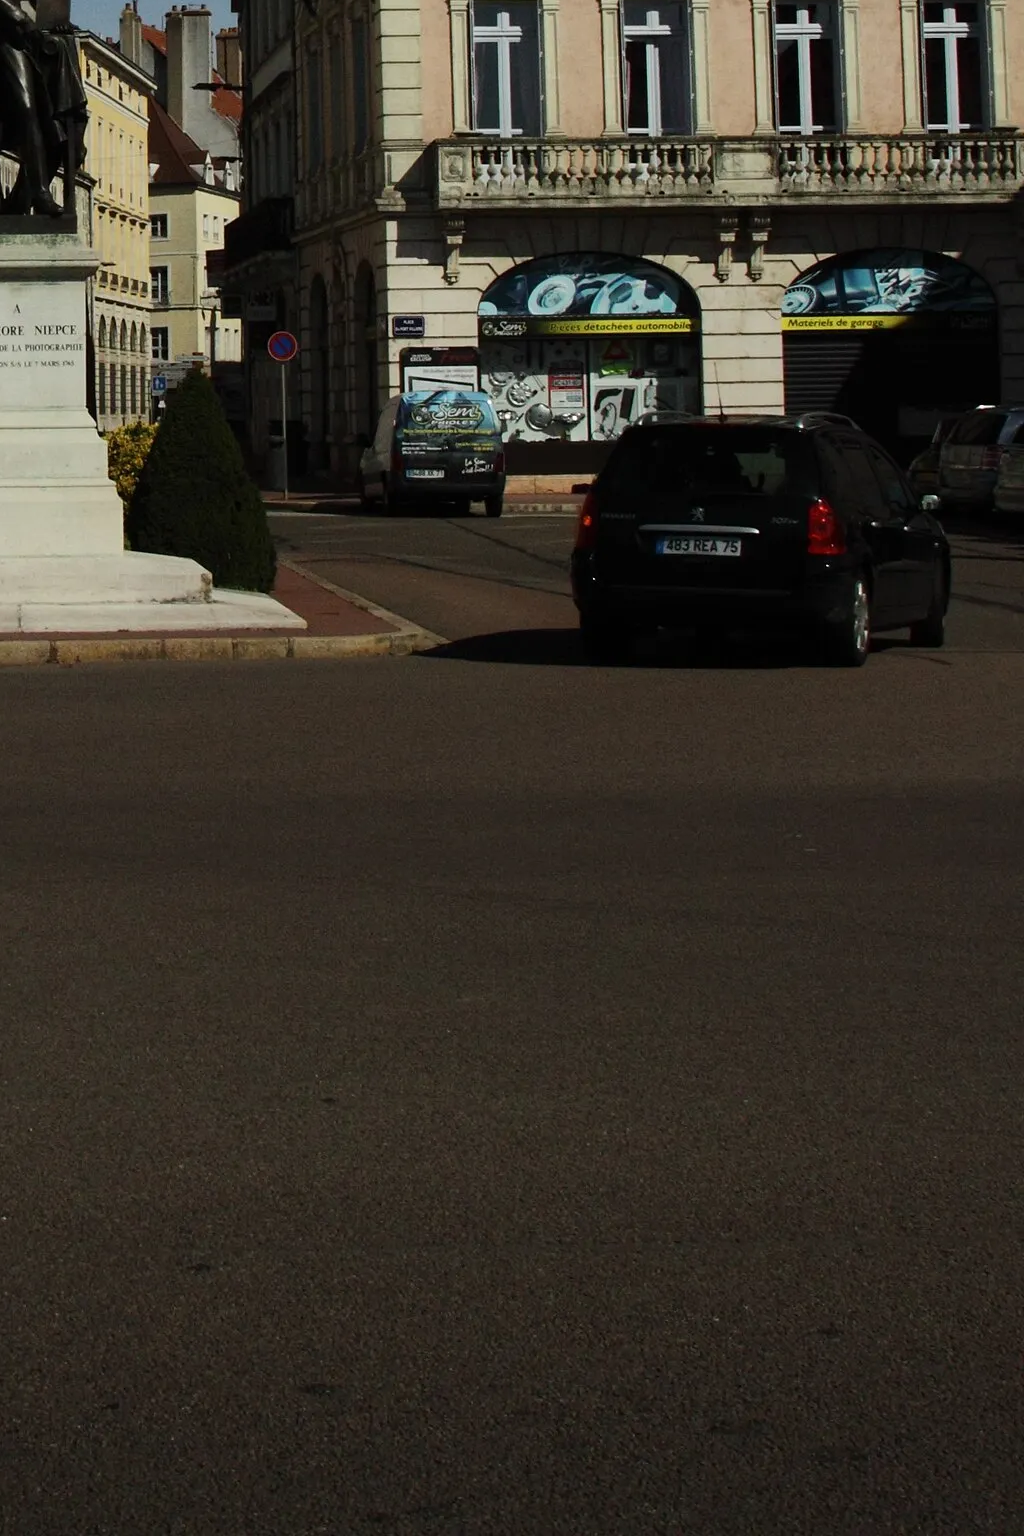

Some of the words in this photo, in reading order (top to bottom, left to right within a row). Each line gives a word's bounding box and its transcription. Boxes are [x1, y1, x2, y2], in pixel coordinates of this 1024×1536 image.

[13, 304, 21, 314] A
[835, 318, 847, 327] de
[850, 319, 883, 329] garage
[34, 324, 77, 336] NIEPCE
[0, 344, 8, 352] DE
[12, 344, 22, 352] LA
[25, 343, 83, 352] PHOTOGRAPHIE
[24, 360, 32, 368] LE
[666, 539, 690, 552] 483
[693, 539, 718, 553] REA
[723, 540, 738, 553] 75
